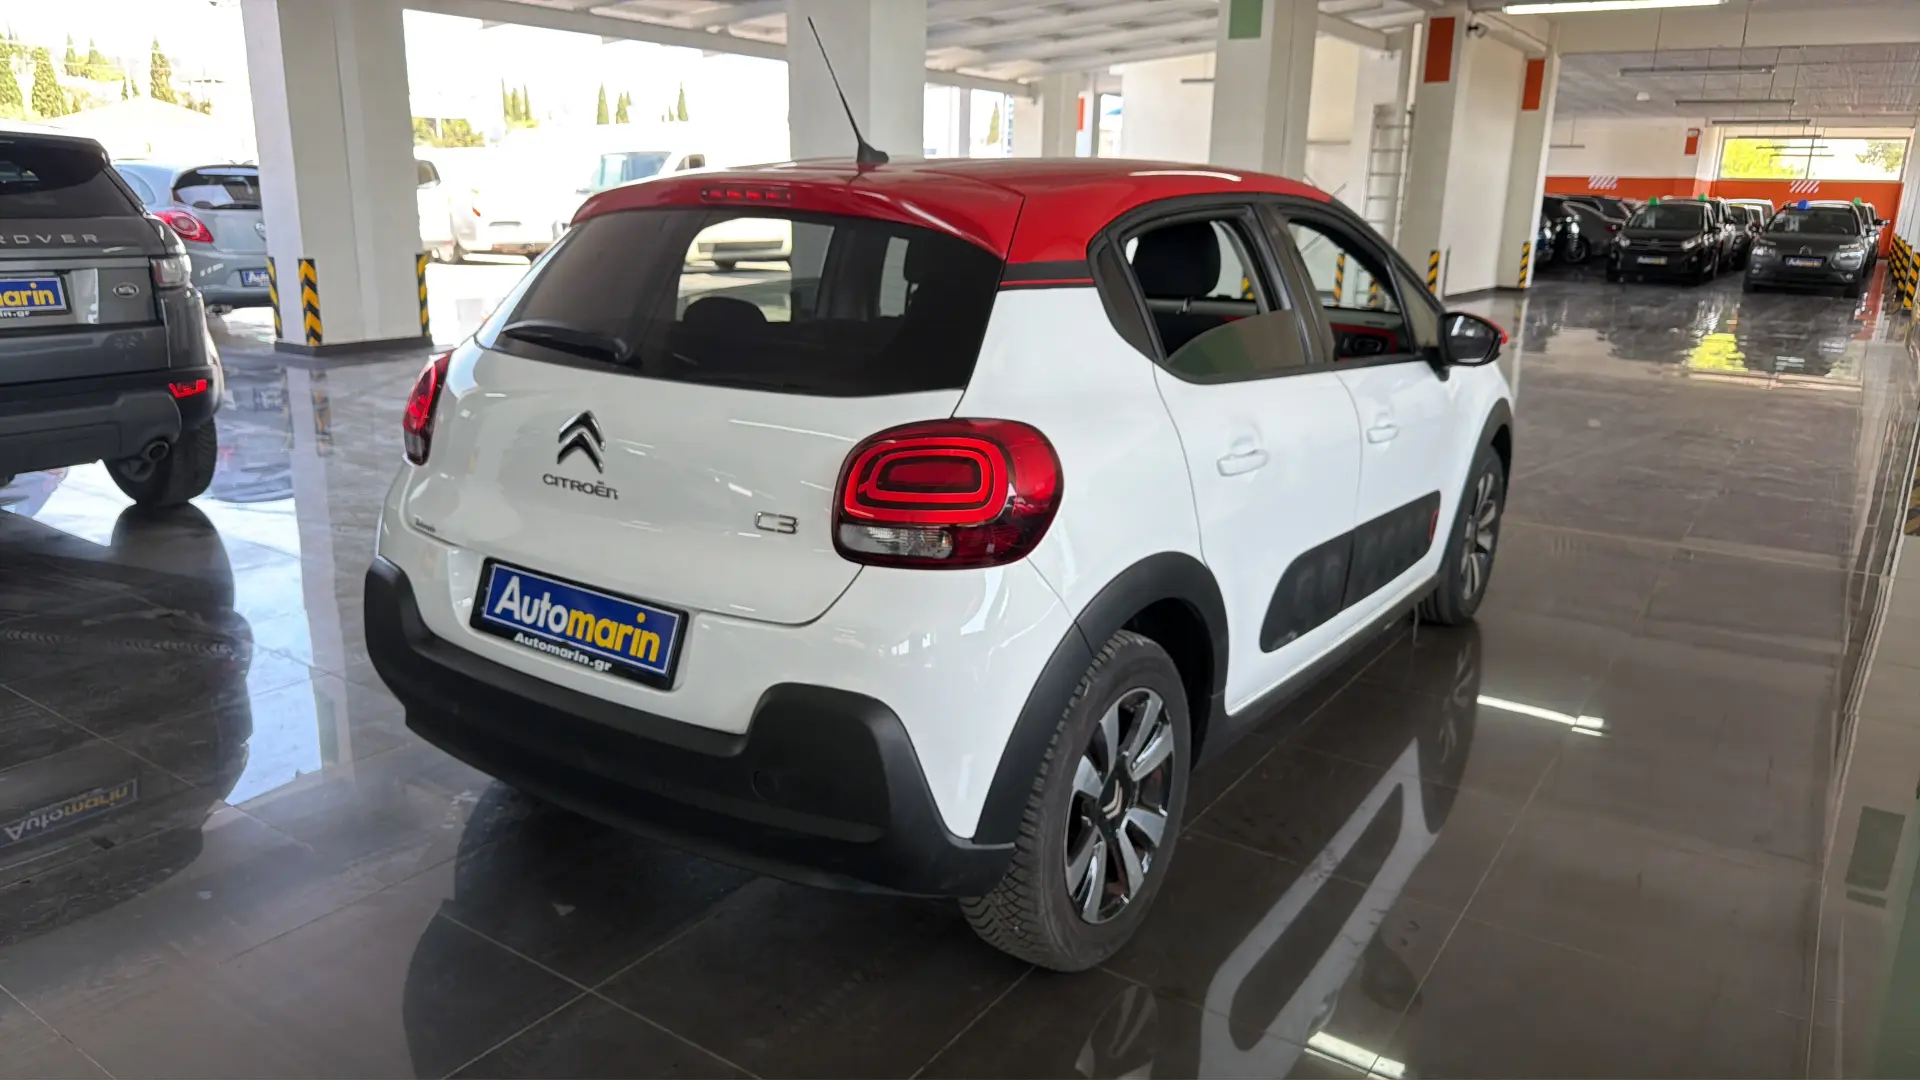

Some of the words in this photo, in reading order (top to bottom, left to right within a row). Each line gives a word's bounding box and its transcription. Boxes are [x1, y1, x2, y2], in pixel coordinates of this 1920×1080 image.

[0, 282, 55, 306] arin
[755, 511, 799, 535] C3
[494, 575, 661, 662] Automarin
[514, 632, 613, 672] Automarin.gr
